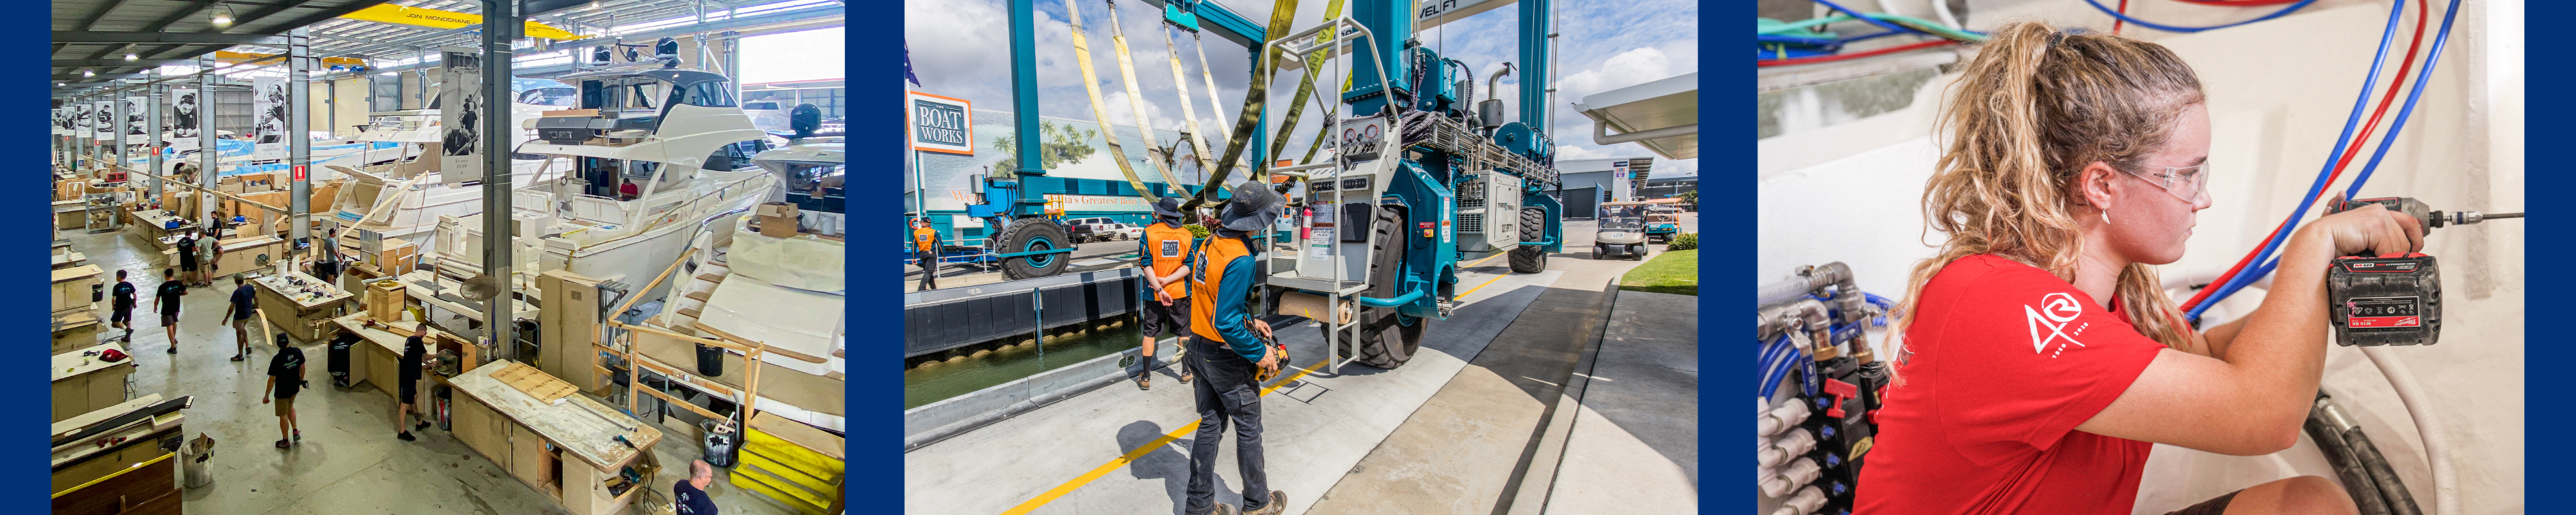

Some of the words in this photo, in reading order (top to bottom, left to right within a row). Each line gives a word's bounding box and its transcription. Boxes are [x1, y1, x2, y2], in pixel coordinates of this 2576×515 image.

[425, 15, 471, 25] MONOCRANE
[919, 106, 962, 131] BOAT
[921, 126, 963, 144] WORKS
[1082, 196, 1118, 206] Greatest
[1120, 196, 1137, 206] Boat
[2074, 322, 2089, 336] 2020
